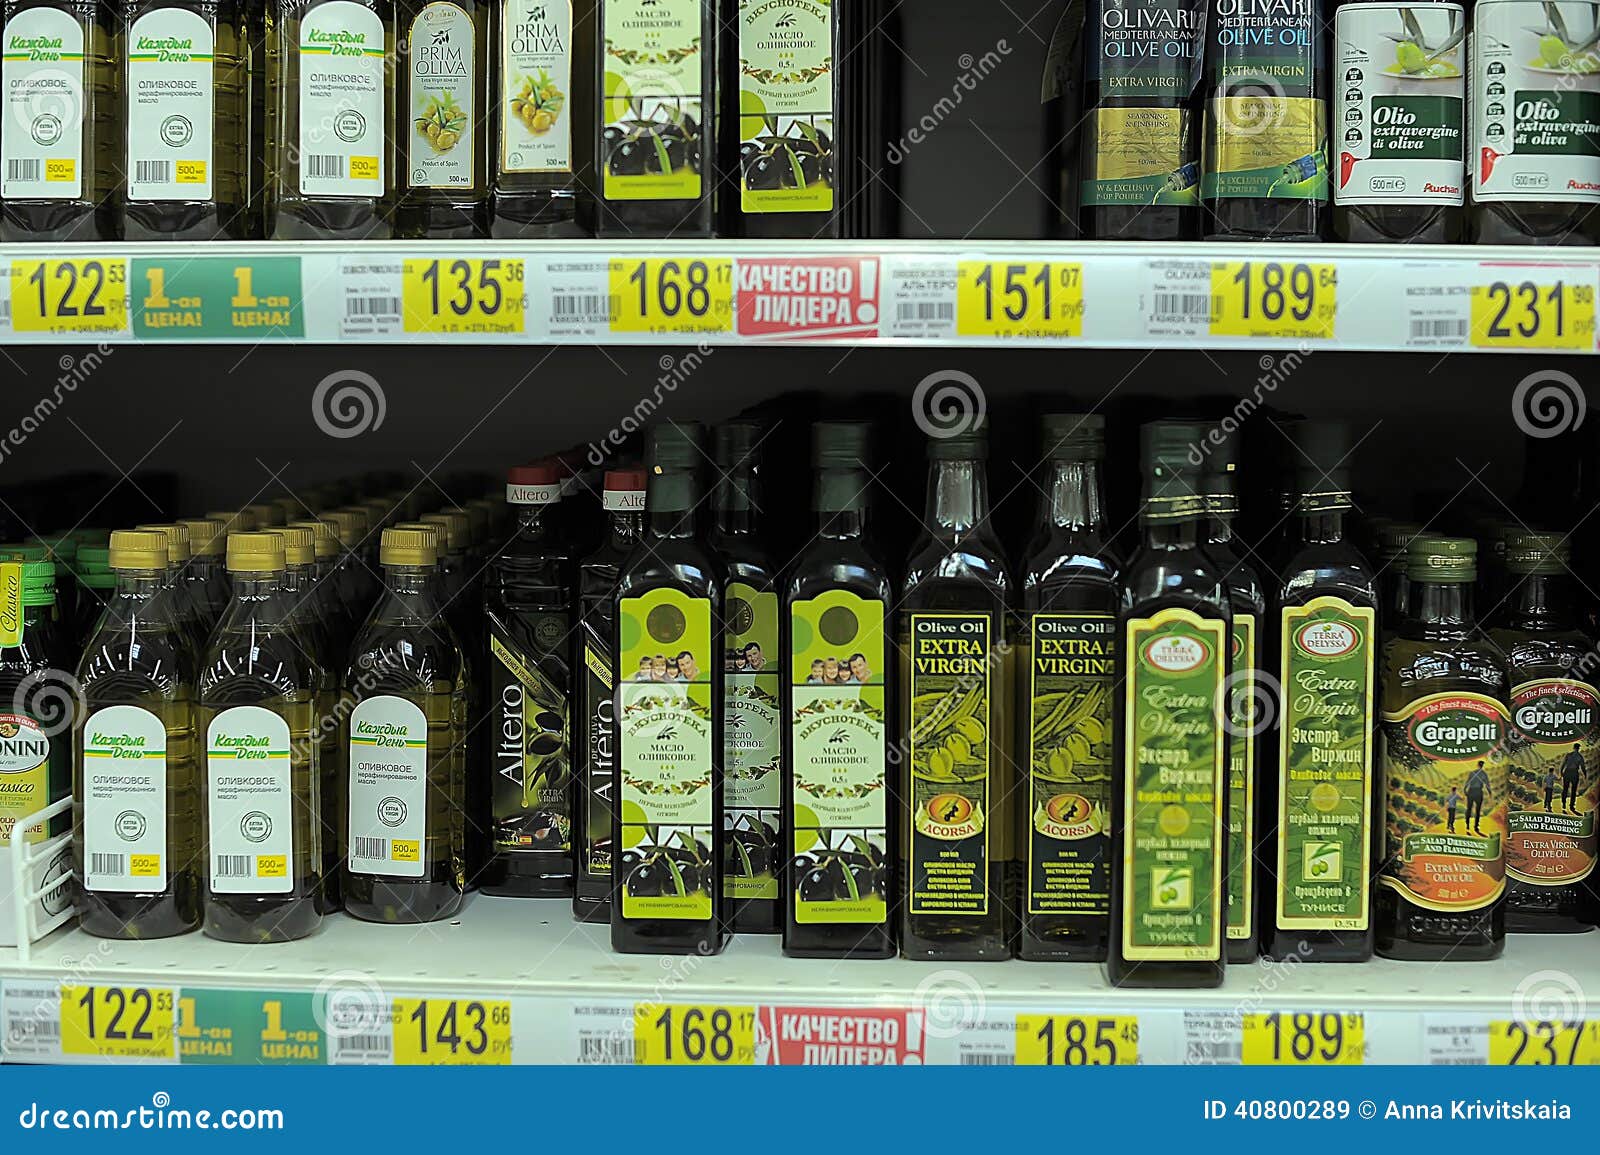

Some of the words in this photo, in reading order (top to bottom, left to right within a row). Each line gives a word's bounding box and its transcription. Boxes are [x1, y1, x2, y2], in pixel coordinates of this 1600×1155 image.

[745, 0, 827, 25] ВКУСНОТЕКА
[1217, 0, 1311, 15] OLIVARI
[1103, 9, 1194, 29] OLIVARI
[1217, 18, 1311, 28] MEDITERRANEAN
[308, 28, 365, 43] Каждый
[515, 25, 558, 38] PRIM
[769, 31, 804, 39] МАСЛО
[1104, 30, 1196, 40] MEDITERRANEAN
[1218, 29, 1274, 46] OLIVE
[1279, 29, 1311, 46] OIL
[9, 36, 63, 50] Каждый
[137, 36, 192, 51] Каждый
[331, 43, 363, 56] День
[511, 39, 564, 53] OLIVA
[757, 40, 816, 49] ОЛИВКОВОЕ
[1104, 41, 1159, 57] OLIVE
[1164, 41, 1195, 57] OIL
[30, 50, 60, 62] День
[159, 50, 191, 63] День
[421, 47, 461, 61] PRIM
[416, 60, 467, 75] OLIVA
[1222, 66, 1258, 77] EXTRA
[1260, 66, 1304, 77] VIRGIN
[11, 79, 67, 89] ОЛИВКОВОЕ
[138, 79, 198, 90] ОЛИВКОВОЕ
[310, 74, 370, 83] ОЛИВКОВОЕ
[1373, 106, 1416, 125] Olio
[1516, 101, 1560, 120] Olio
[1373, 124, 1459, 139] extravergine
[1515, 134, 1527, 144] di
[1531, 132, 1567, 145] oliva
[1373, 139, 1384, 149] di
[1389, 137, 1424, 150] oliva
[1423, 183, 1459, 194] Auchan
[738, 263, 852, 295] КАЧЕСТВО
[30, 261, 105, 317] 122
[108, 264, 126, 283] 53
[423, 260, 501, 315] 135
[506, 263, 524, 282] 36
[630, 261, 709, 317] 168
[717, 265, 732, 283] 17
[976, 264, 1051, 320] 151
[1061, 268, 1079, 288] 07
[1234, 262, 1315, 321] 189
[1487, 281, 1563, 338] 231
[144, 311, 202, 327] ЦЕНА!
[231, 311, 290, 327] ЦЕНА!
[511, 488, 549, 500] Altero
[1, 575, 17, 633] Classico
[917, 623, 957, 633] Olive
[960, 623, 984, 633] Oil
[1038, 623, 1078, 633] Olive
[1081, 623, 1105, 633] Oil
[1312, 632, 1342, 640] TERRA
[920, 639, 983, 655] EXTRA
[1041, 639, 1104, 655] EXTRA
[1307, 640, 1347, 648] DELYSSA
[916, 659, 985, 674] VIRGIN
[1037, 659, 1105, 674] VIRGIN
[1296, 670, 1357, 692] Extra
[1142, 684, 1208, 708] Extra
[1537, 687, 1557, 697] finest
[1294, 693, 1359, 724] Virgin
[1437, 701, 1460, 710] finest
[628, 712, 707, 738] ВКУСНОТЕКА
[1515, 706, 1591, 730] Carapelli
[357, 720, 408, 735] Каждый
[799, 715, 880, 740] ВКУСНОТЕКА
[1140, 709, 1210, 743] Virgin
[1536, 729, 1574, 737] FIRENZE
[91, 732, 145, 747] Каждый
[215, 733, 269, 747] Каждый
[374, 734, 406, 748] День
[497, 684, 523, 787] Altero
[1292, 727, 1339, 747] Экстра
[1415, 721, 1496, 747] Carapelli
[111, 747, 142, 759] День
[235, 747, 267, 760] День
[650, 744, 684, 752] МАСЛО
[823, 747, 857, 755] МАСЛО
[1436, 746, 1478, 754] FIRENZE
[638, 754, 696, 762] ОЛИВКОВОЕ
[810, 756, 869, 764] ОЛИВКОВОЕ
[1138, 746, 1189, 768] Экстра
[1311, 747, 1361, 767] Виржин
[358, 762, 411, 773] ОЛИВКОВОЕ
[93, 776, 151, 784] ОЛИВКОВОЕ
[217, 777, 276, 785] ОЛИВКОВОЕ
[357, 772, 417, 780] нерафинированное
[1159, 766, 1213, 788] Виржин
[1290, 813, 1318, 827] первый
[1321, 813, 1359, 826] холодный
[1544, 816, 1583, 827] DRESSINGS
[923, 823, 975, 836] ACORSA
[1042, 823, 1094, 836] ACORSA
[1308, 826, 1338, 835] отжим
[1522, 822, 1539, 830] AND
[1540, 823, 1580, 834] FLAVORING
[1420, 836, 1445, 846] SALAD
[1447, 837, 1488, 849] DRESSINGS
[1523, 839, 1549, 849] EXTRA
[1550, 839, 1579, 849] VIRGIN
[1423, 845, 1441, 853] AND
[1442, 845, 1485, 857] FLAVORING
[1530, 850, 1554, 858] OLIVE
[1555, 850, 1570, 858] OIL
[1425, 863, 1452, 873] EXTRA
[1452, 863, 1485, 873] VIRGIN
[1300, 904, 1345, 912] ТУНИСЕ
[79, 987, 153, 1040] 122
[158, 992, 173, 1011] 53
[412, 1000, 488, 1054] 143
[492, 1006, 510, 1025] 66
[656, 1007, 733, 1061] 168
[738, 1013, 755, 1032] 17
[781, 1014, 899, 1046] КАЧЕСТВО
[1037, 1018, 1117, 1065] 185
[1121, 1023, 1140, 1043] 48
[1265, 1012, 1343, 1061] 189
[1507, 1021, 1585, 1065] 237
[179, 1042, 233, 1057] ЦЕНА!
[261, 1044, 318, 1059] ЦЕНА!
